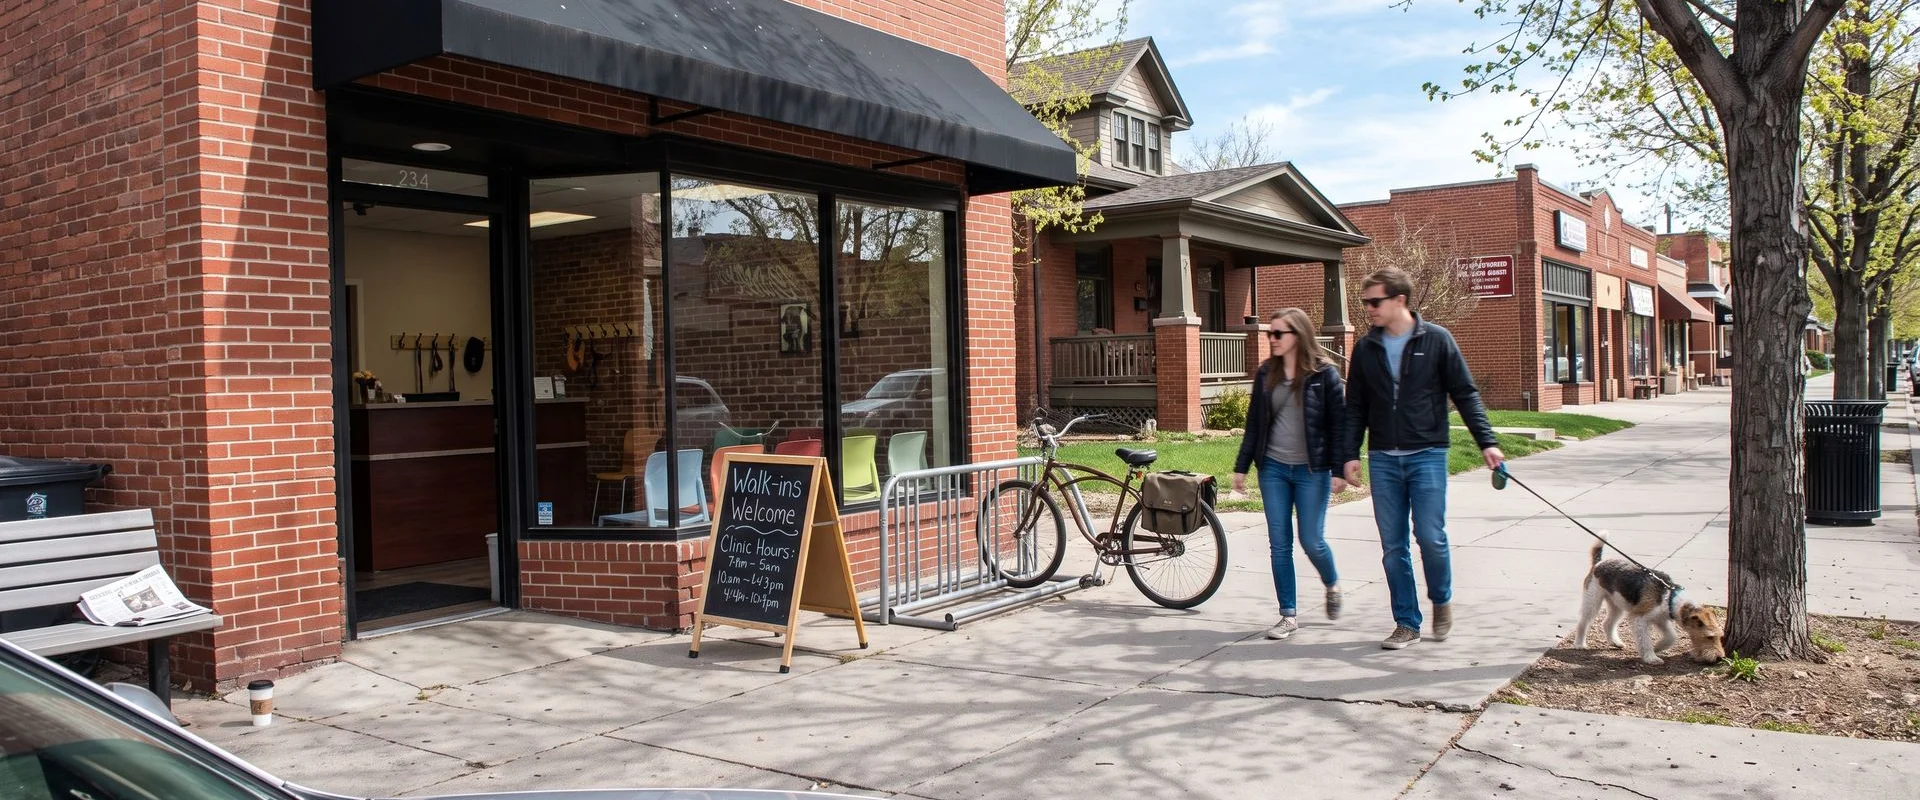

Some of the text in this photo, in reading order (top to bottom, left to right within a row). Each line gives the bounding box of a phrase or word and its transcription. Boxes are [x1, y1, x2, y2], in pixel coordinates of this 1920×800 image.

[399, 170, 429, 190] 234
[733, 467, 802, 498] Walk-ins
[731, 496, 796, 525] Welcome
[720, 534, 796, 560] Clinic Hours:
[759, 558, 781, 573] 5am
